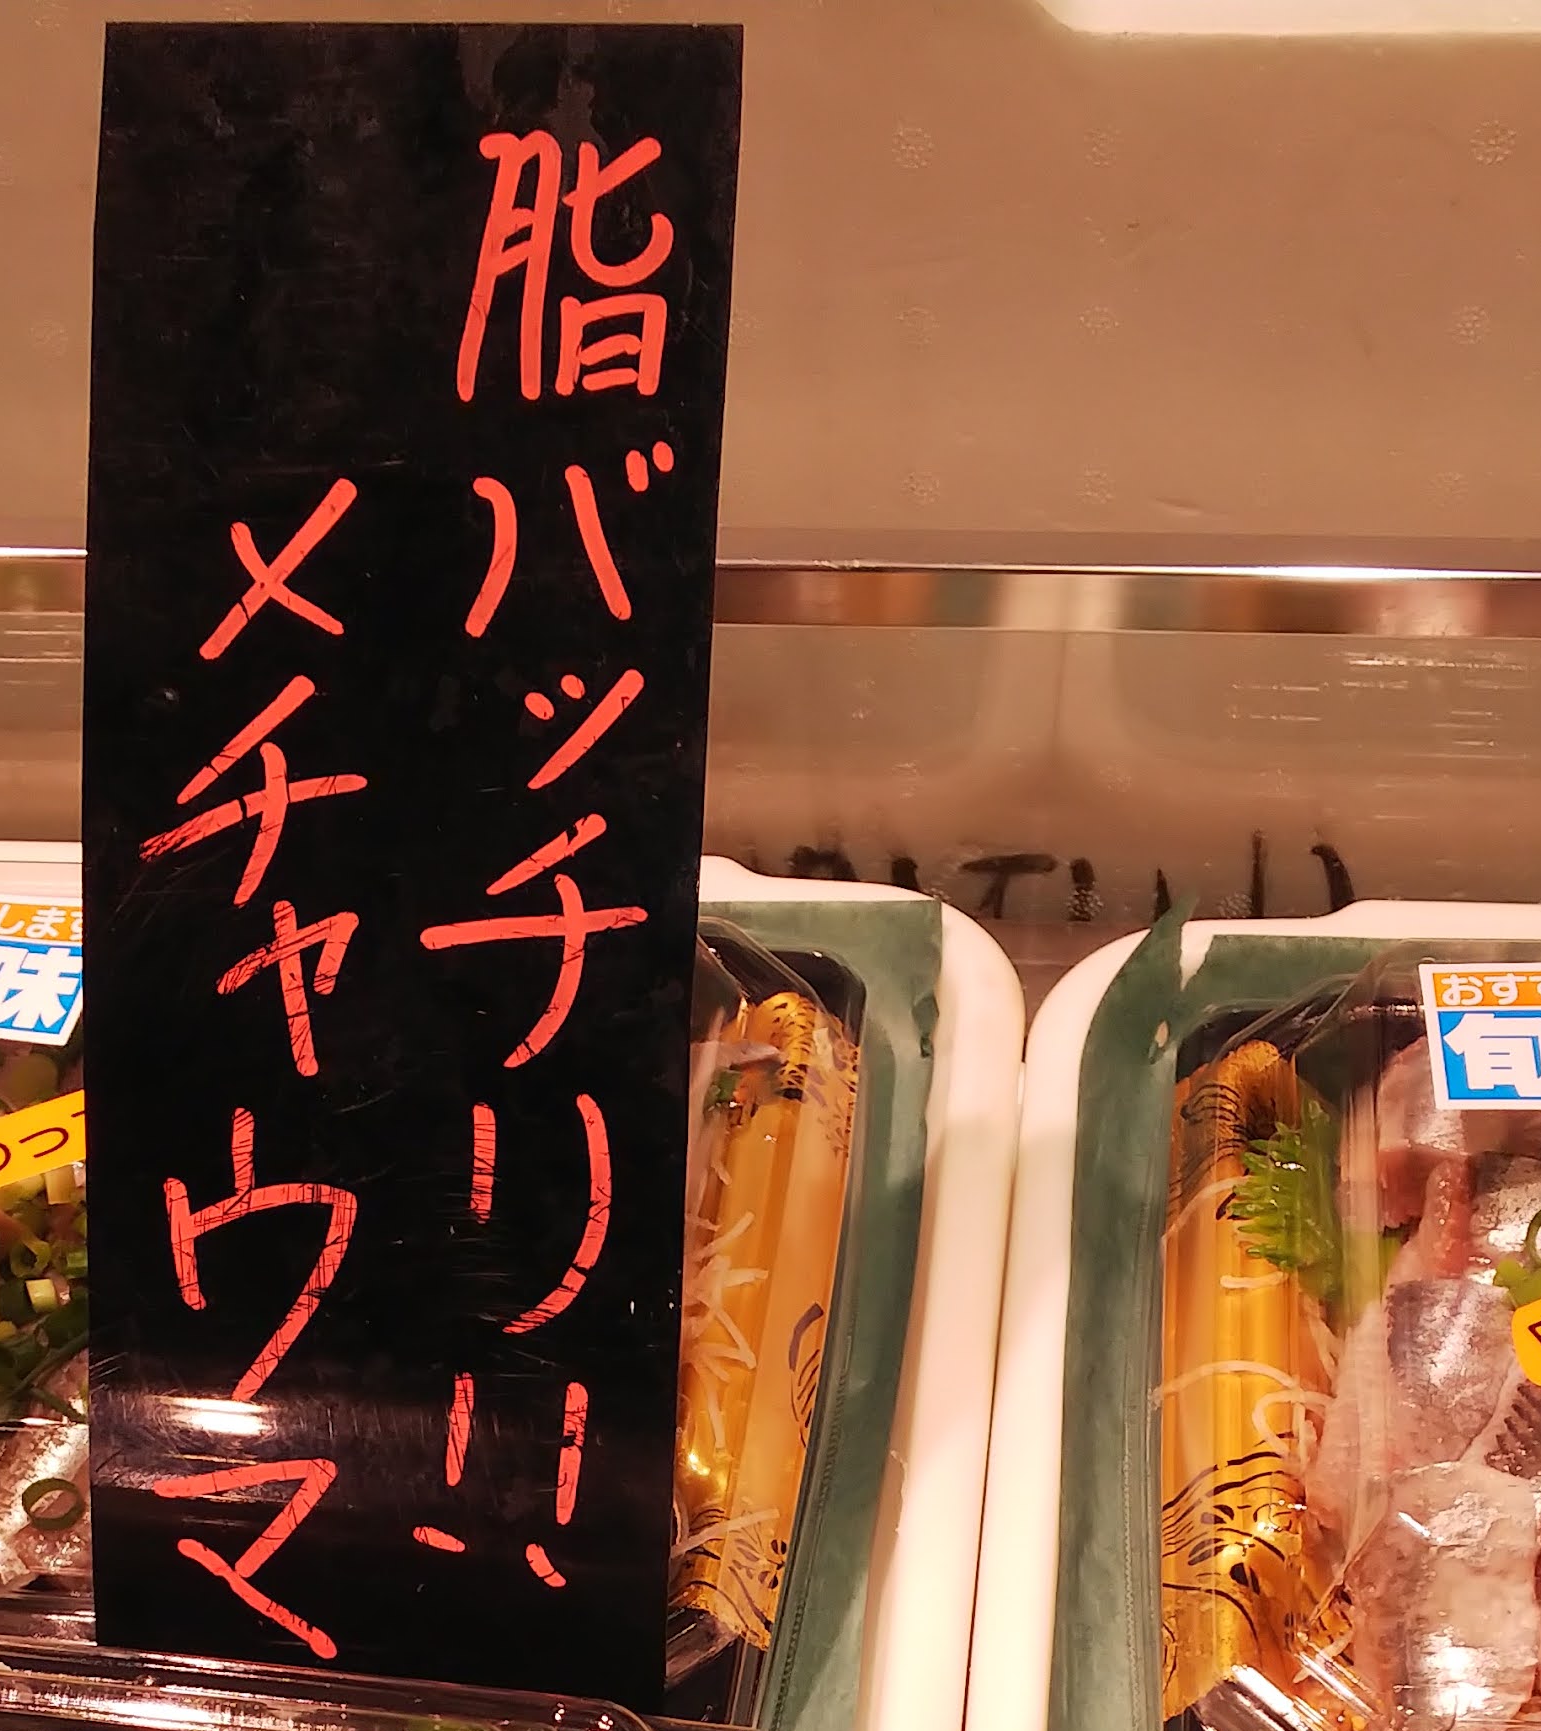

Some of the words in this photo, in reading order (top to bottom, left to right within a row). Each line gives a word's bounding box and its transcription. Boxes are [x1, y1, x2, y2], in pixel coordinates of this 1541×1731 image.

[139, 478, 368, 1659] メチャウマ
